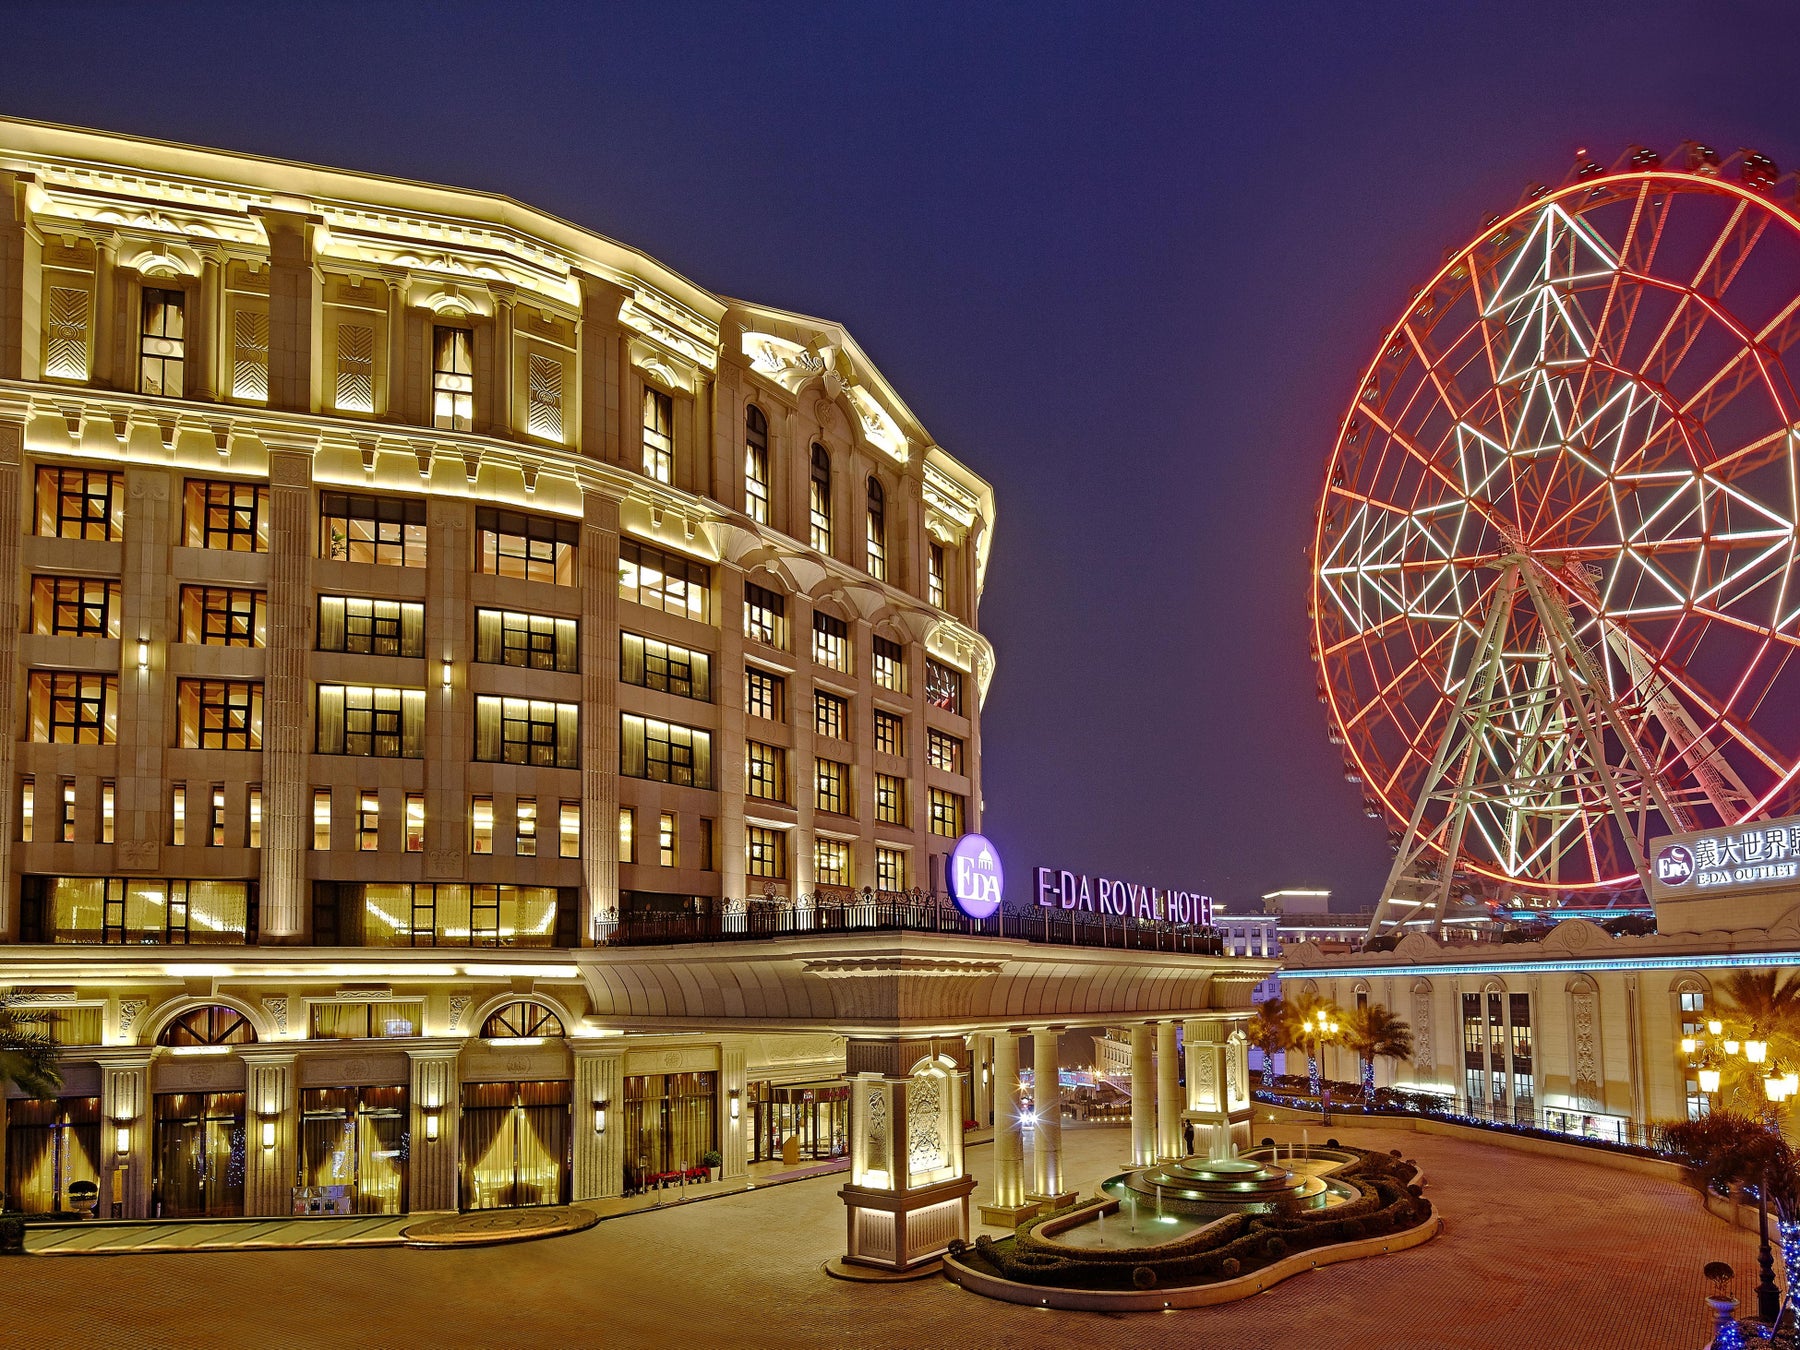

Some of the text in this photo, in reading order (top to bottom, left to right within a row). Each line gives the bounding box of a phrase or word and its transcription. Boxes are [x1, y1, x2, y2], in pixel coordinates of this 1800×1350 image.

[956, 855, 1001, 903] EDA
[1658, 857, 1691, 879] EDA
[1734, 864, 1794, 880] OUTLET
[1037, 867, 1217, 928] E-DA ROYAL HOTEL
